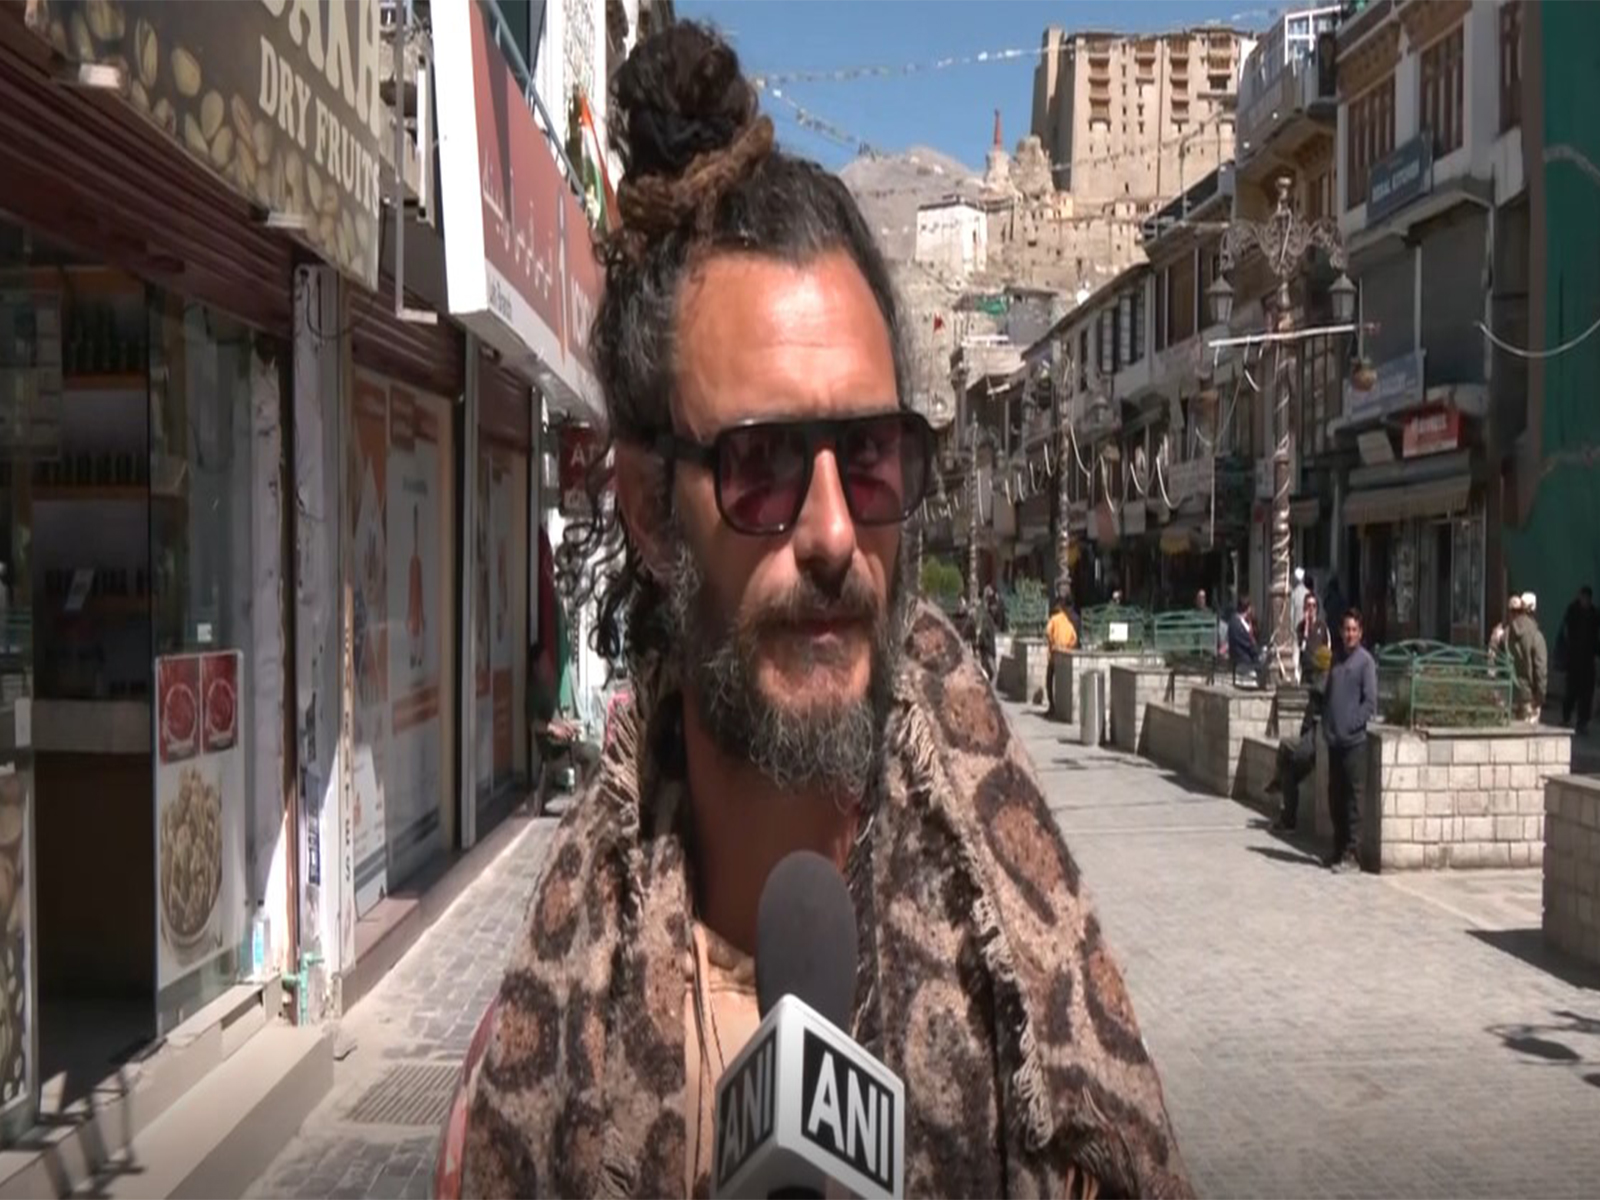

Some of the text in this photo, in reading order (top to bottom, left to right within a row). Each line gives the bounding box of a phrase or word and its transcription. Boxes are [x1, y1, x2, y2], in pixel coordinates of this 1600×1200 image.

[259, 34, 380, 220] DRY FRUITS
[720, 1041, 773, 1183] ANI
[807, 1050, 890, 1183] ANI
